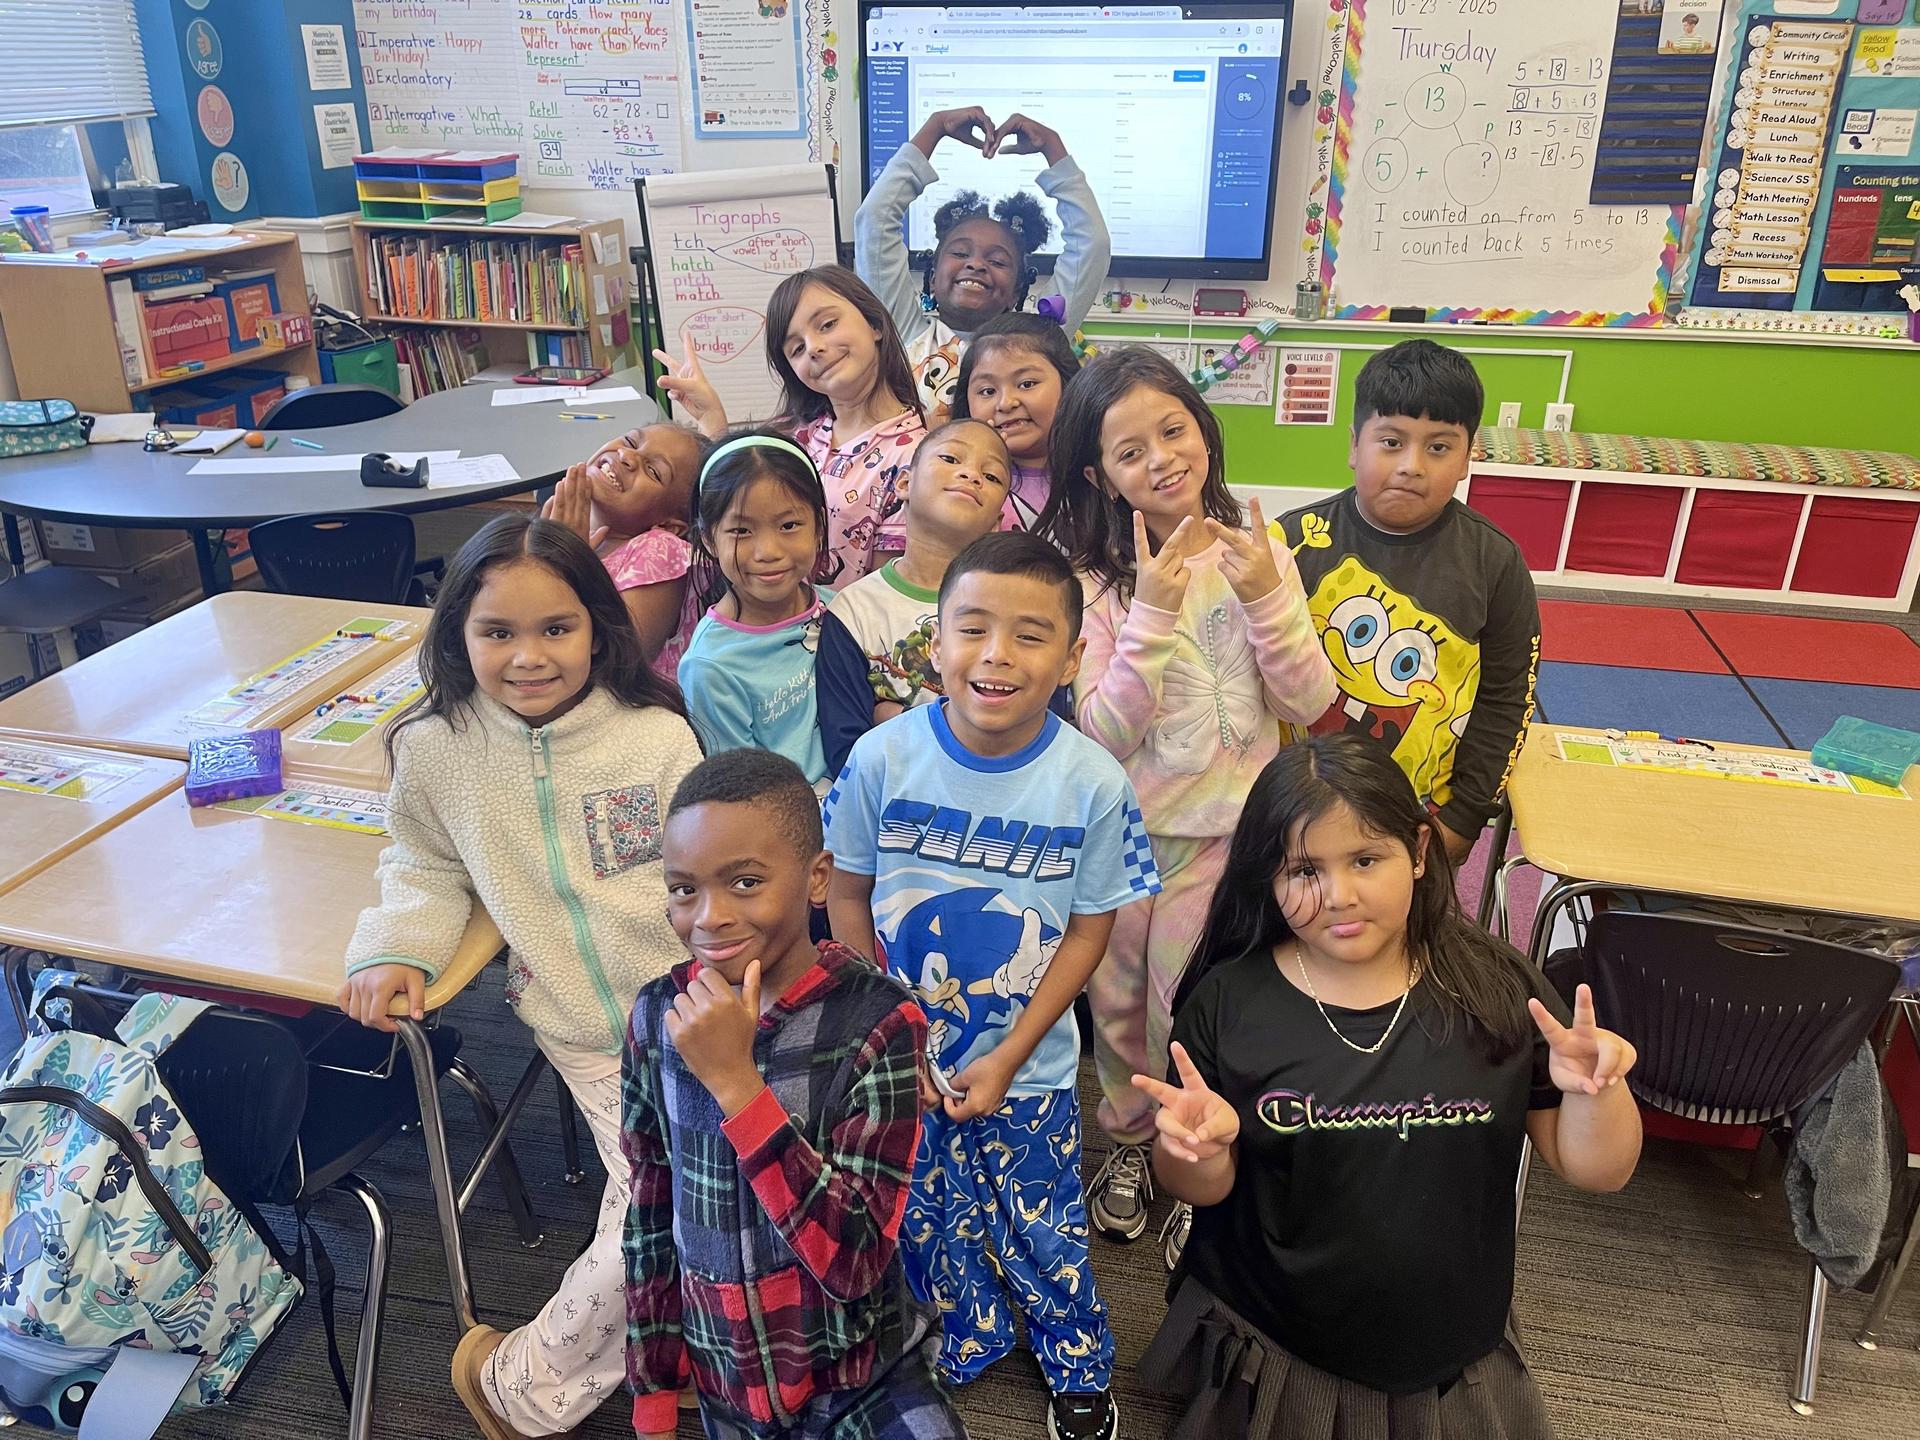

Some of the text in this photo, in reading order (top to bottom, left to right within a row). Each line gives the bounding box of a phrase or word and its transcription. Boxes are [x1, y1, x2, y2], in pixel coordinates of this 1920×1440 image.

[366, 8, 380, 23] my
[518, 10, 533, 20] 28
[590, 6, 613, 20] How
[621, 11, 652, 23] many
[1865, 12, 1881, 22] Say
[520, 26, 546, 35] more
[607, 20, 634, 36] cards
[644, 20, 668, 36] does
[445, 32, 482, 54] Happy
[522, 35, 667, 50] Walter have than Kevin?
[1778, 31, 1846, 41] Community Circle
[1863, 35, 1889, 43] Yellow
[1392, 28, 1497, 74] Thursday
[1784, 51, 1820, 63] Writing
[374, 49, 430, 69] Birthday!
[1322, 33, 1341, 86] Welcome!
[1515, 58, 1603, 80] 5 8 13
[1769, 70, 1824, 81] Enrichment
[1238, 92, 1251, 102] 8%
[1772, 87, 1816, 96] Structured
[1425, 87, 1445, 112] 13
[1516, 91, 1597, 109] 8 5 13
[466, 105, 503, 122] What
[593, 105, 609, 118] 62
[625, 103, 641, 118] 28
[822, 87, 837, 133] Welcome!
[1761, 114, 1817, 124] Read Aloud
[386, 121, 409, 135] date
[420, 123, 430, 134] is
[439, 124, 465, 143] your
[1509, 120, 1590, 137] 13 5 8
[1770, 133, 1798, 142] Lunch
[545, 144, 559, 156] 34
[1505, 146, 1584, 169] 13 8 5
[1750, 153, 1772, 162] Walk
[1789, 155, 1814, 163] Read
[588, 159, 624, 176] Walter
[631, 161, 651, 175] has
[1376, 153, 1392, 181] 5
[588, 175, 614, 183] more
[1751, 173, 1809, 184] Science/ SS
[1853, 176, 1919, 187] Counting the
[1745, 193, 1810, 206] Math Meeting
[1838, 195, 1878, 203] hundreds
[687, 204, 781, 233] Trigraphs
[1375, 202, 1387, 222] I
[1403, 201, 1467, 224] counted
[1481, 211, 1501, 224] on
[1518, 205, 1556, 224] from
[1573, 208, 1584, 225] 5
[1607, 208, 1624, 225] to
[1739, 213, 1800, 222] Math Lesson
[673, 232, 704, 248] tch
[748, 235, 807, 248] after short
[1372, 231, 1384, 251] I
[1402, 231, 1468, 256] counted
[1484, 227, 1523, 252] back
[1541, 236, 1552, 253] 5
[1752, 233, 1786, 242] Recess
[733, 246, 760, 256] vowel
[1756, 252, 1794, 261] Workshop
[672, 256, 714, 271] hatch
[673, 273, 711, 291] pitch
[1737, 275, 1780, 285] Dismissal
[676, 284, 720, 300] match
[721, 312, 745, 321] short
[150, 314, 223, 338] Instructional Cards Kit
[694, 334, 735, 356] bridge
[1180, 351, 1186, 360] 3
[1258, 352, 1266, 362] 4
[758, 668, 811, 711] Hello Kitt
[762, 702, 789, 724] And
[1657, 750, 1687, 759] Andy
[1750, 760, 1799, 773] Sandoval
[878, 798, 1085, 883] SONIC
[1256, 1088, 1495, 1141] Champion
